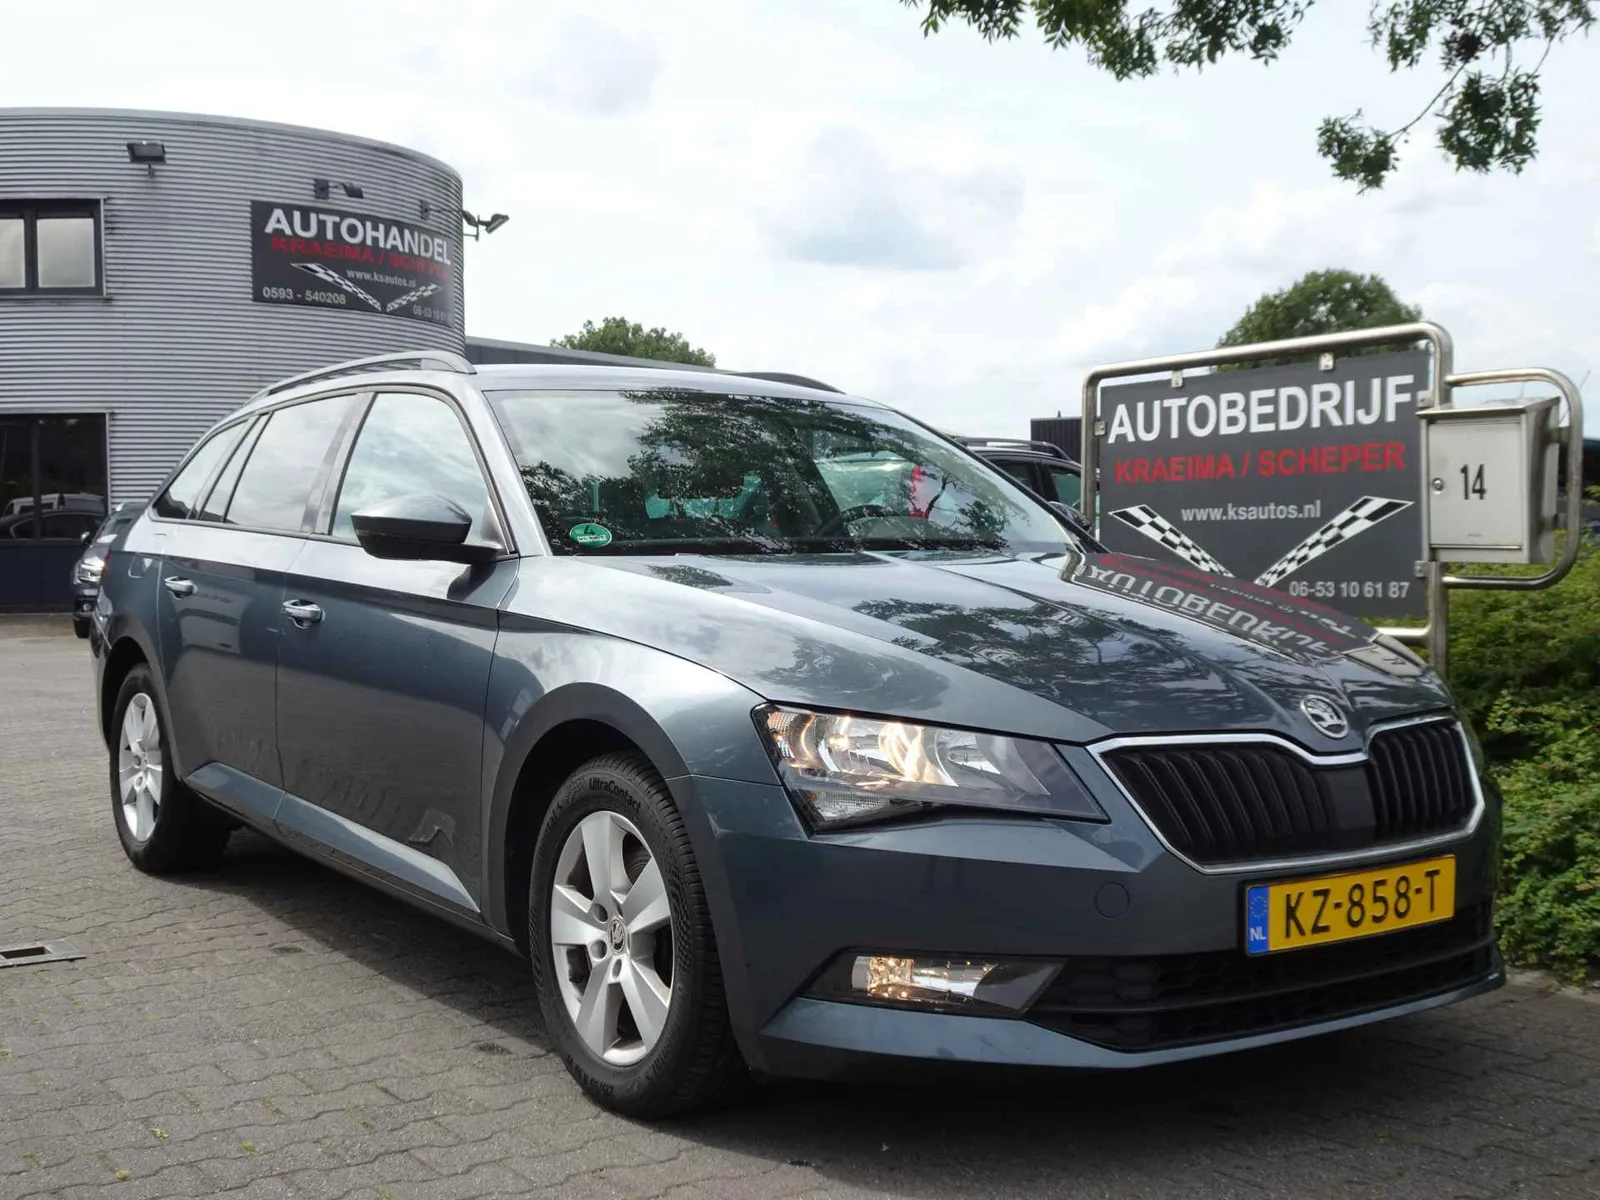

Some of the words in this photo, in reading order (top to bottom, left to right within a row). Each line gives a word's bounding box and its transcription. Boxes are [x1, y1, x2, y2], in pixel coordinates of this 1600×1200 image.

[264, 208, 451, 265] AUTOHANDEL
[271, 235, 375, 264] KRAEIMA
[346, 268, 416, 289] www.ksautos.nl
[262, 286, 294, 301] 0593
[305, 288, 346, 305] 540208
[1108, 374, 1415, 444] AUTOBEDRIJF
[1114, 454, 1236, 485] KRAEIMA
[1242, 452, 1250, 478] /
[1257, 441, 1406, 477] SCHEPER
[1460, 463, 1487, 500] 14
[1180, 500, 1322, 522] www.ksautos.nl
[1289, 581, 1335, 598] 06-53
[1339, 582, 1360, 598] 10
[1362, 581, 1383, 598] 61
[1388, 581, 1410, 598] 87
[589, 778, 642, 815] UltraContact
[1285, 869, 1441, 939] KZ-858-T
[1250, 926, 1267, 942] NL
